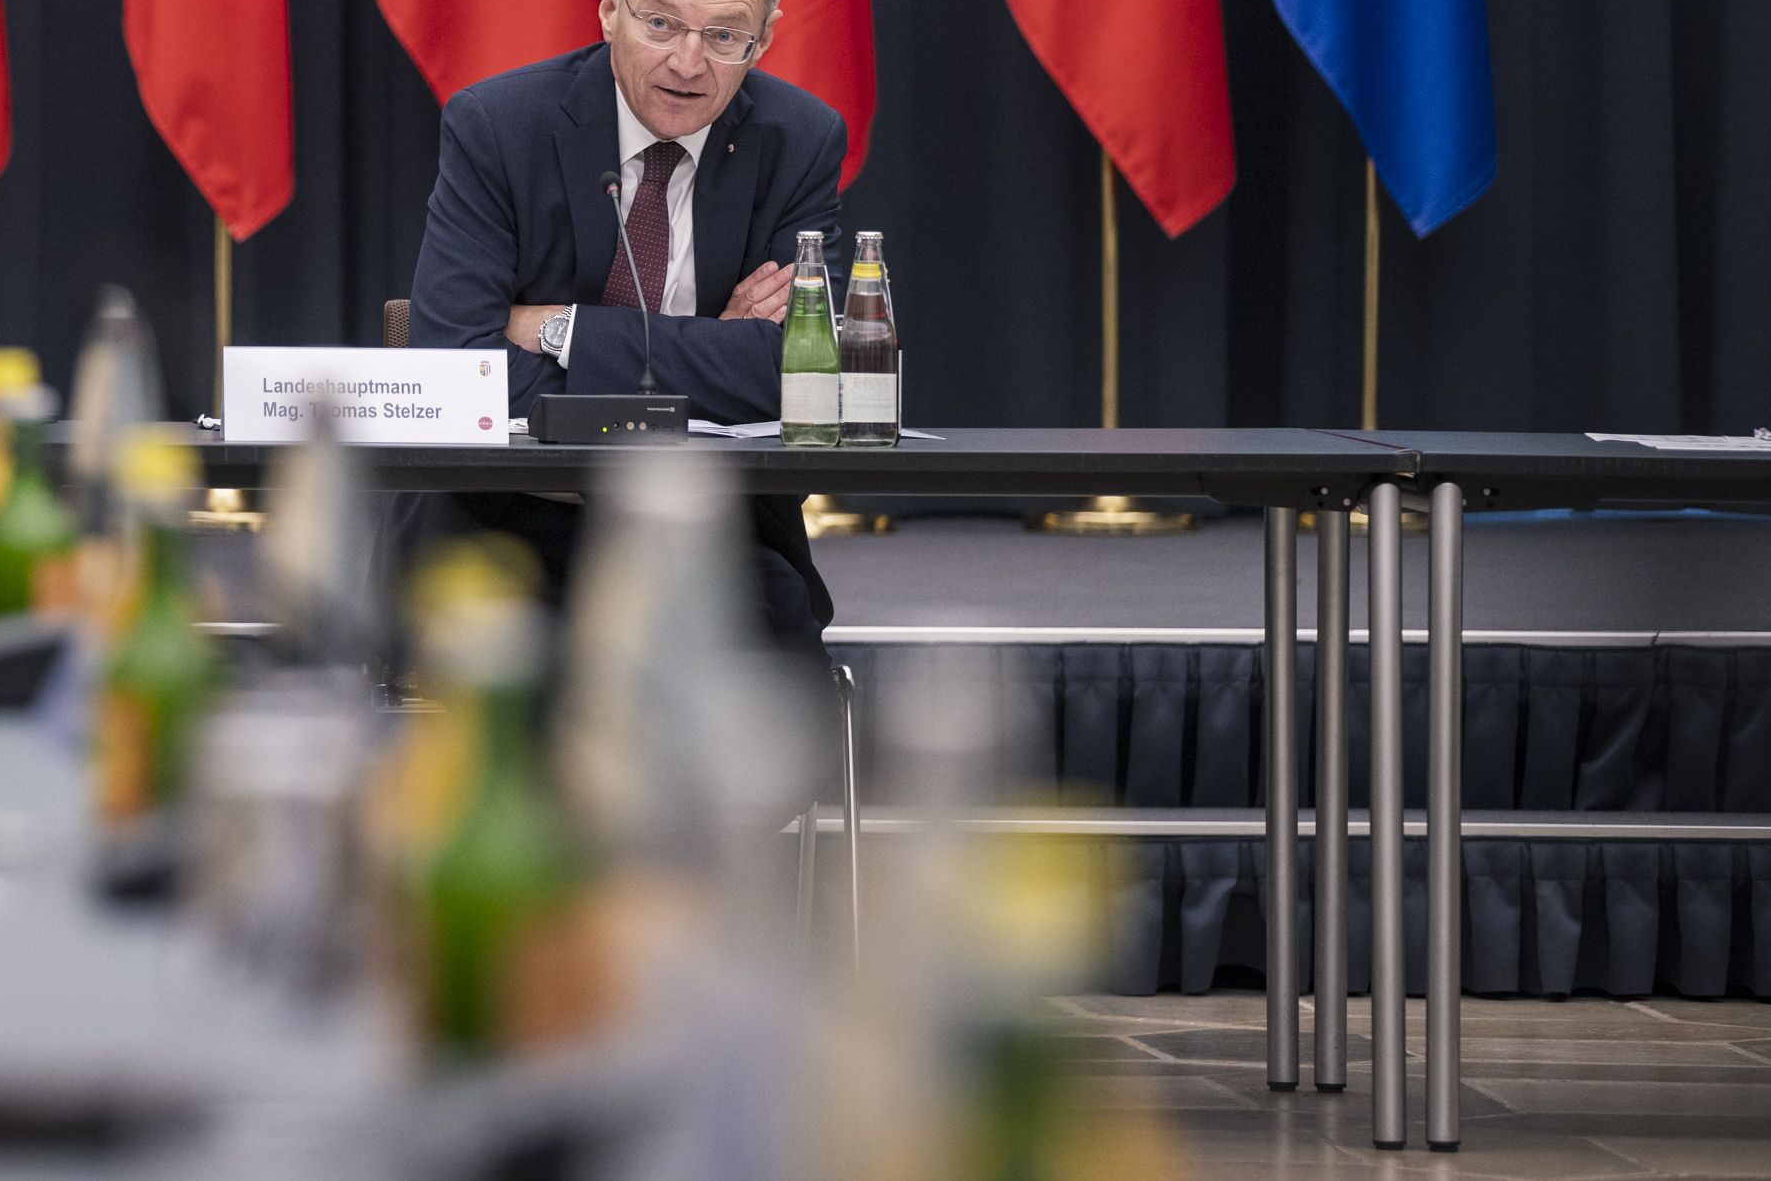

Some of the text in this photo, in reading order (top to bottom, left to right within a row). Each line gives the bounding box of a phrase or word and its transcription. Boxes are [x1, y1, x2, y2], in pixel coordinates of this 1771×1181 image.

[263, 378, 422, 397] Landeshauptmann
[263, 402, 442, 421] Mag. Tomas Stelzer
